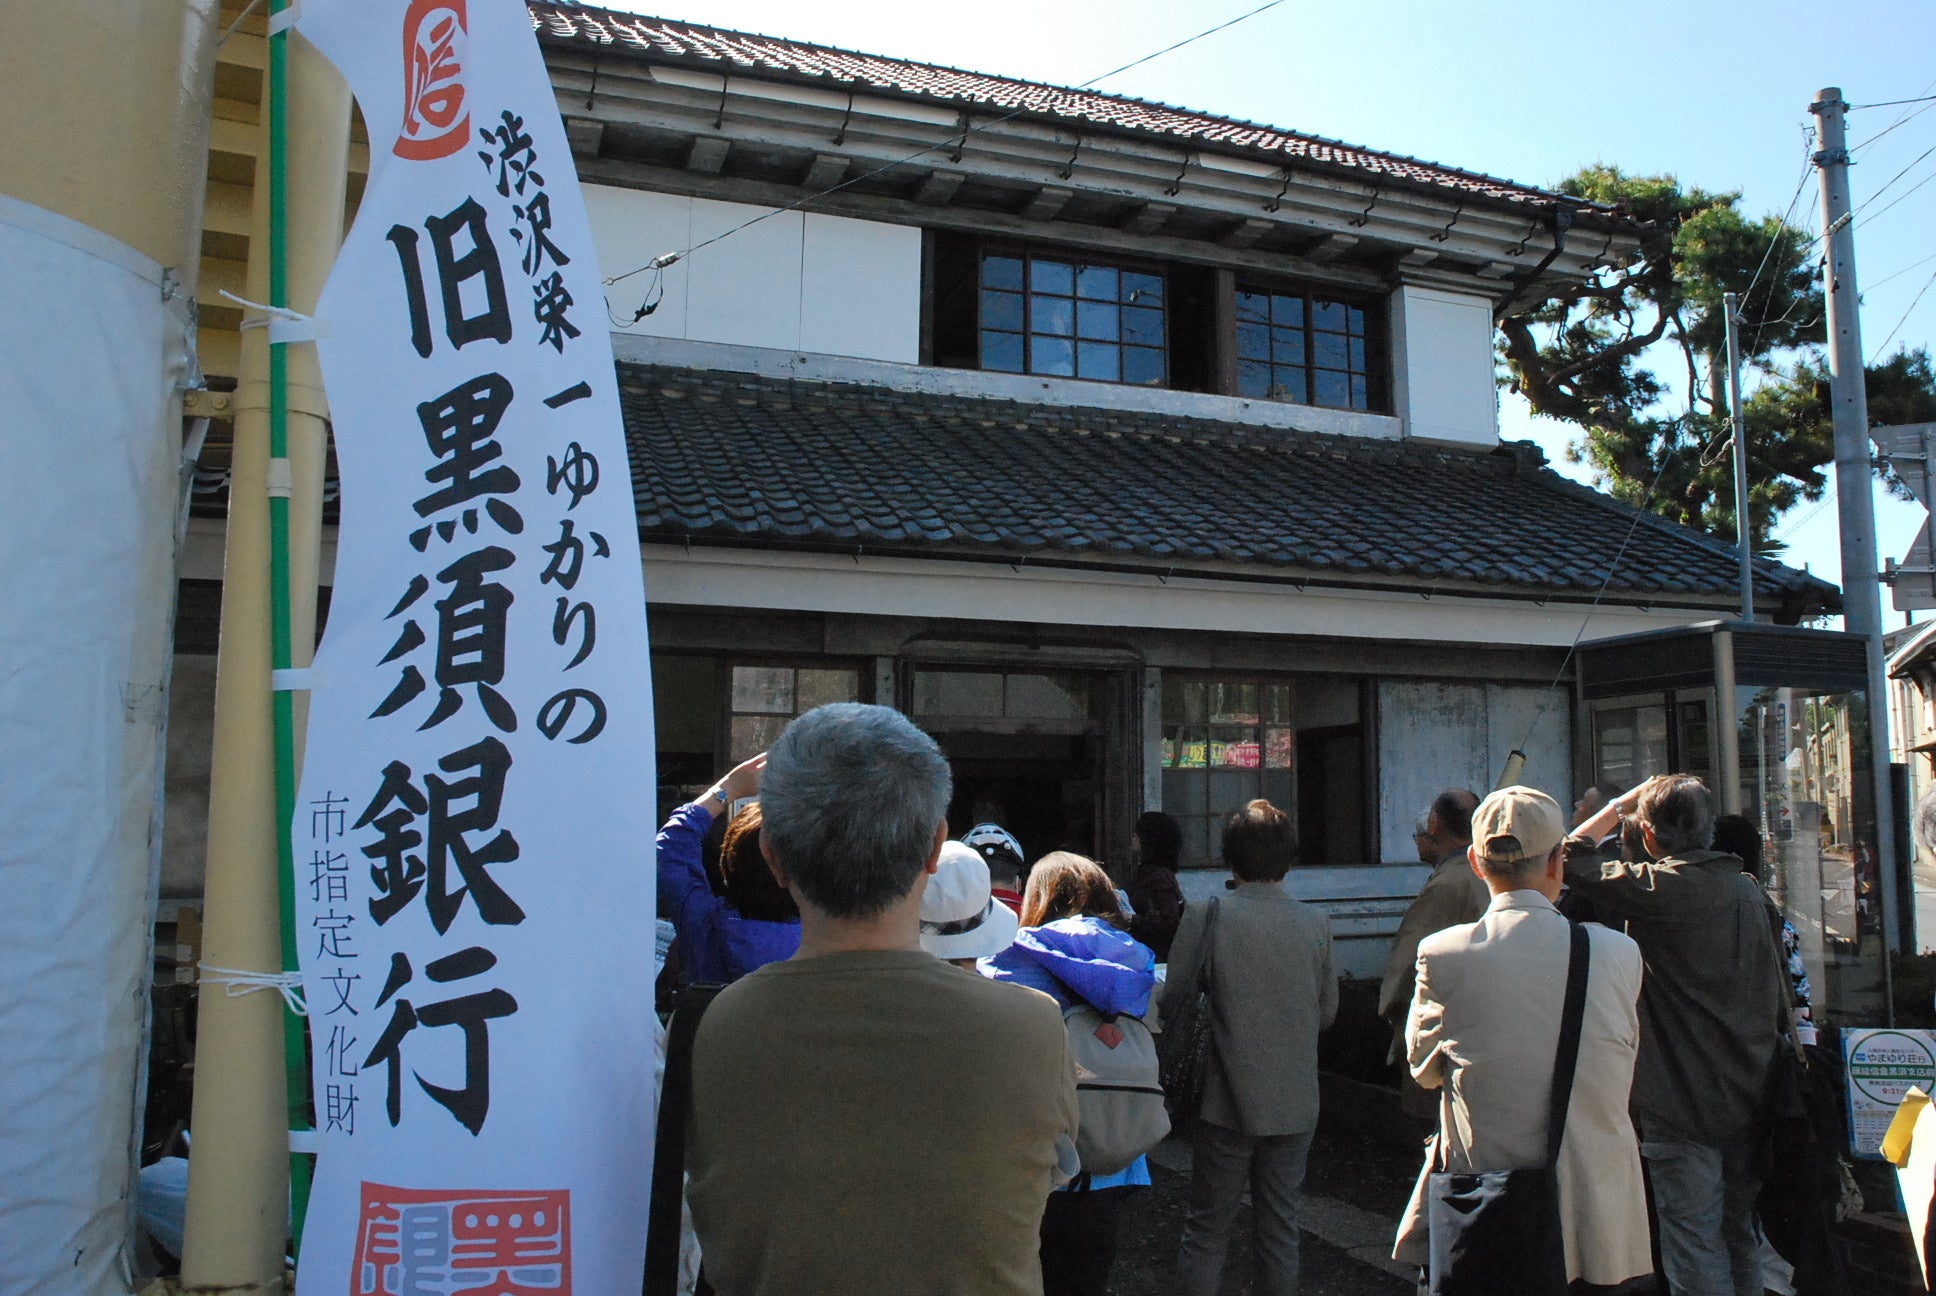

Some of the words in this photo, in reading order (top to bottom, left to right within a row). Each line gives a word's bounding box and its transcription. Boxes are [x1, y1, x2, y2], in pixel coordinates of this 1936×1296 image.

[350, 196, 527, 1138] 旧黒須銀行
[478, 110, 610, 745] 渋沢栄一ゆかりの
[308, 790, 361, 1137] 市指定文化財
